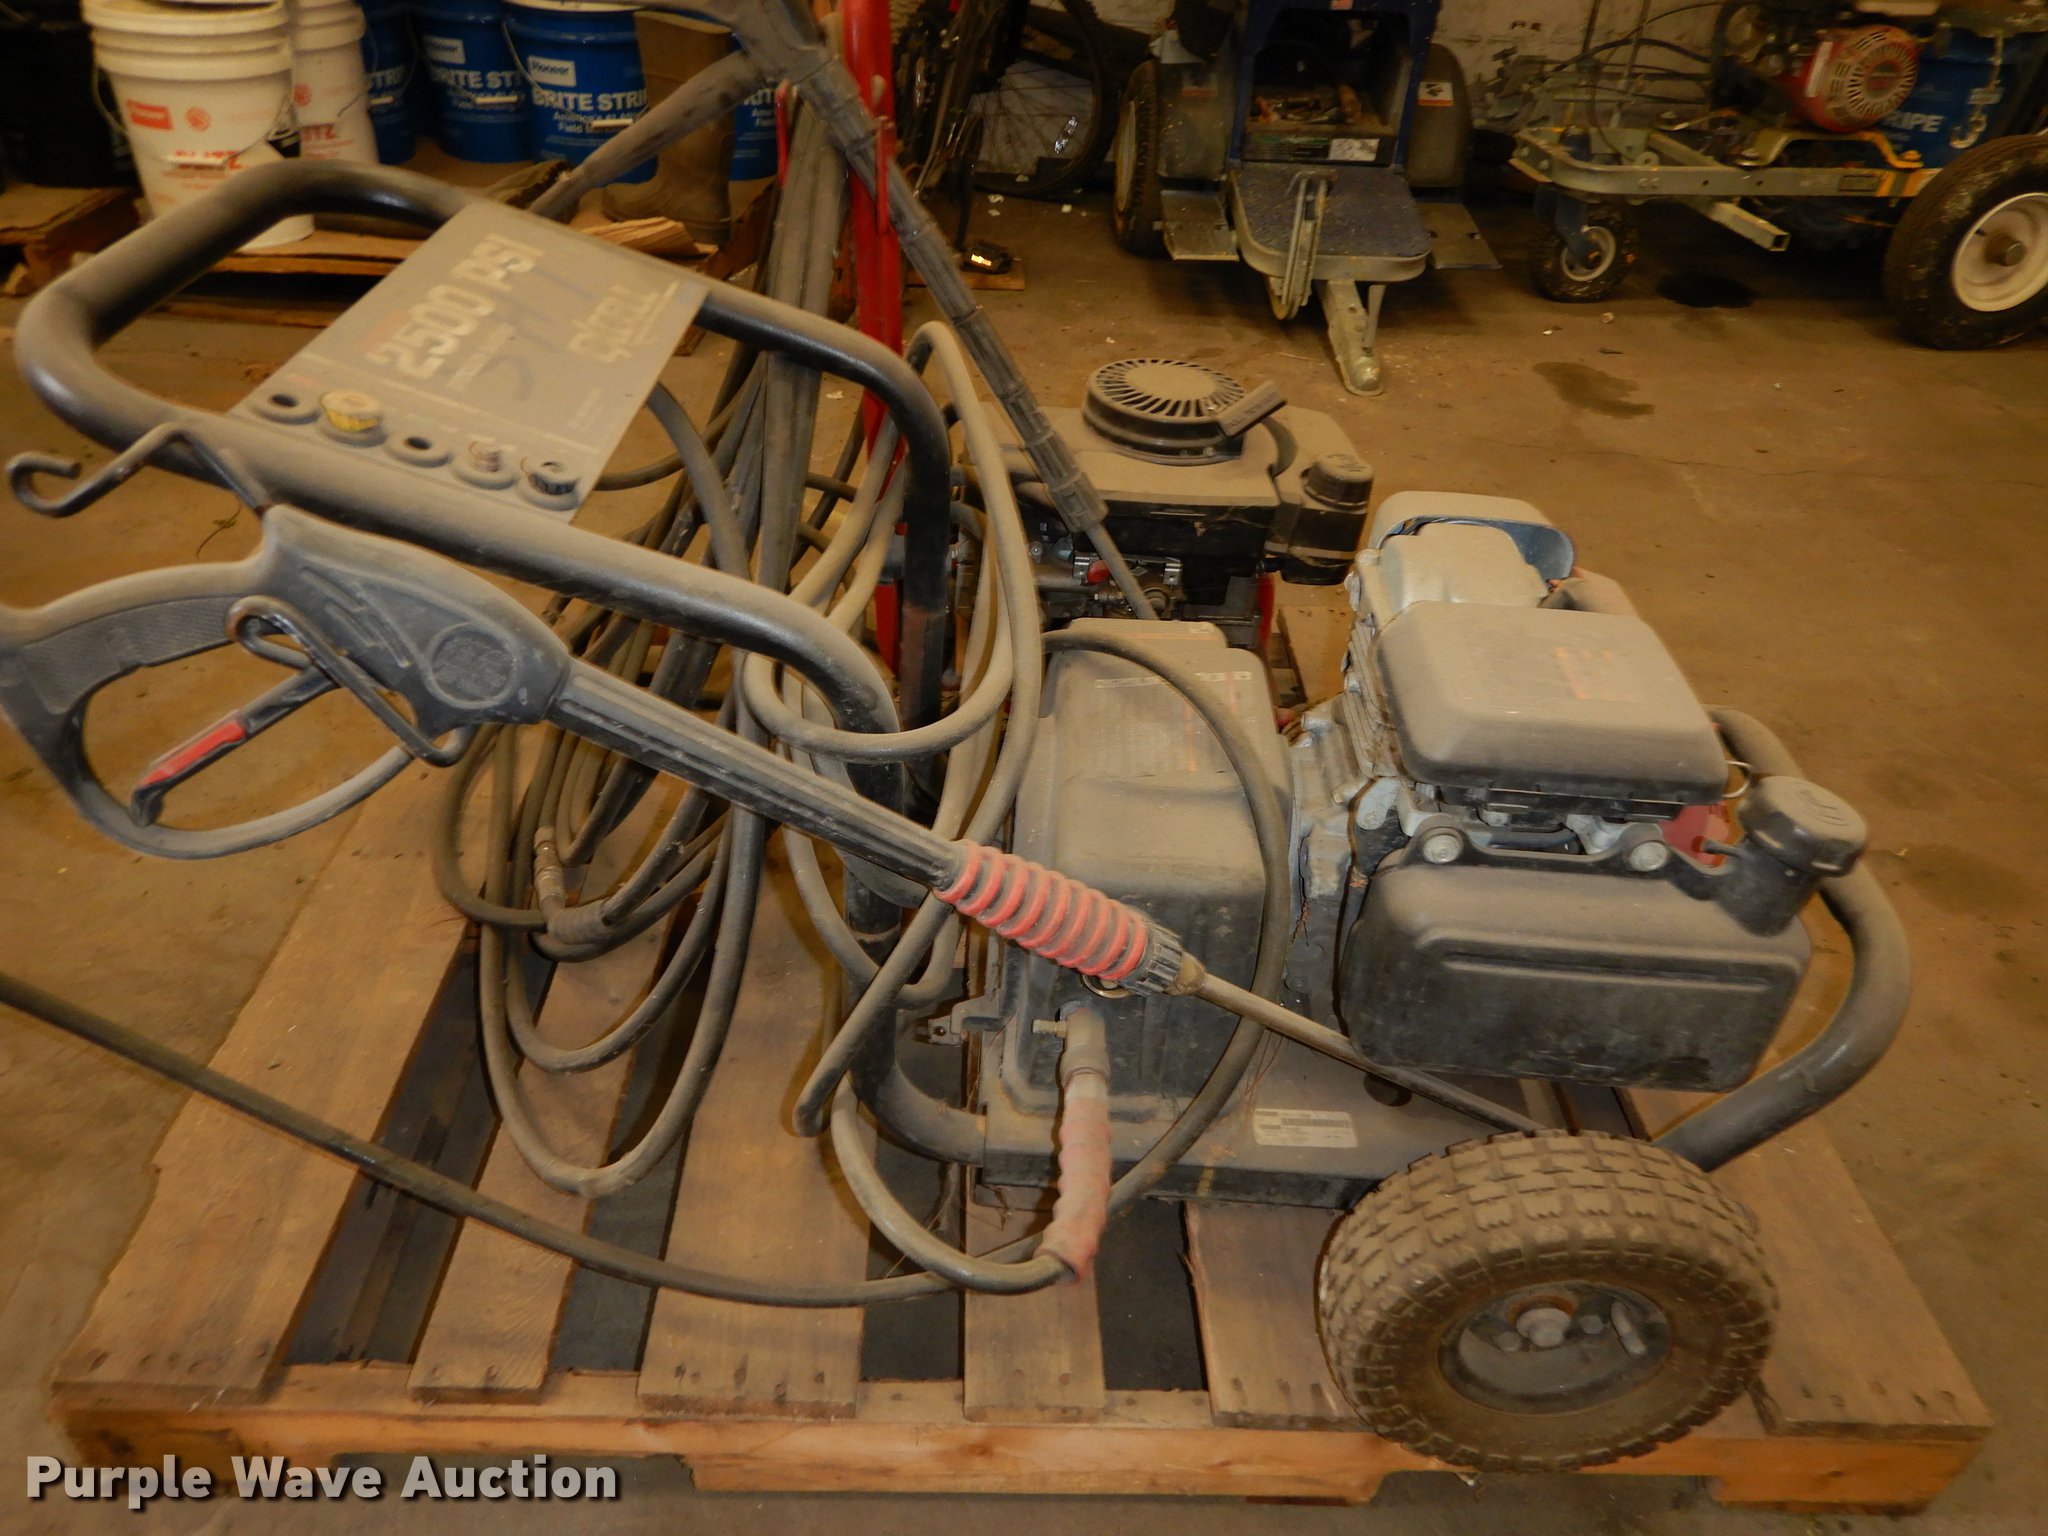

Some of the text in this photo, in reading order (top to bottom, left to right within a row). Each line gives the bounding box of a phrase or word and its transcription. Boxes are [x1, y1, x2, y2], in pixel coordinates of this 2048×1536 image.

[531, 88, 595, 112] BRITE
[597, 88, 648, 112] STRI
[363, 283, 497, 380] 2500
[451, 232, 546, 293] PSI
